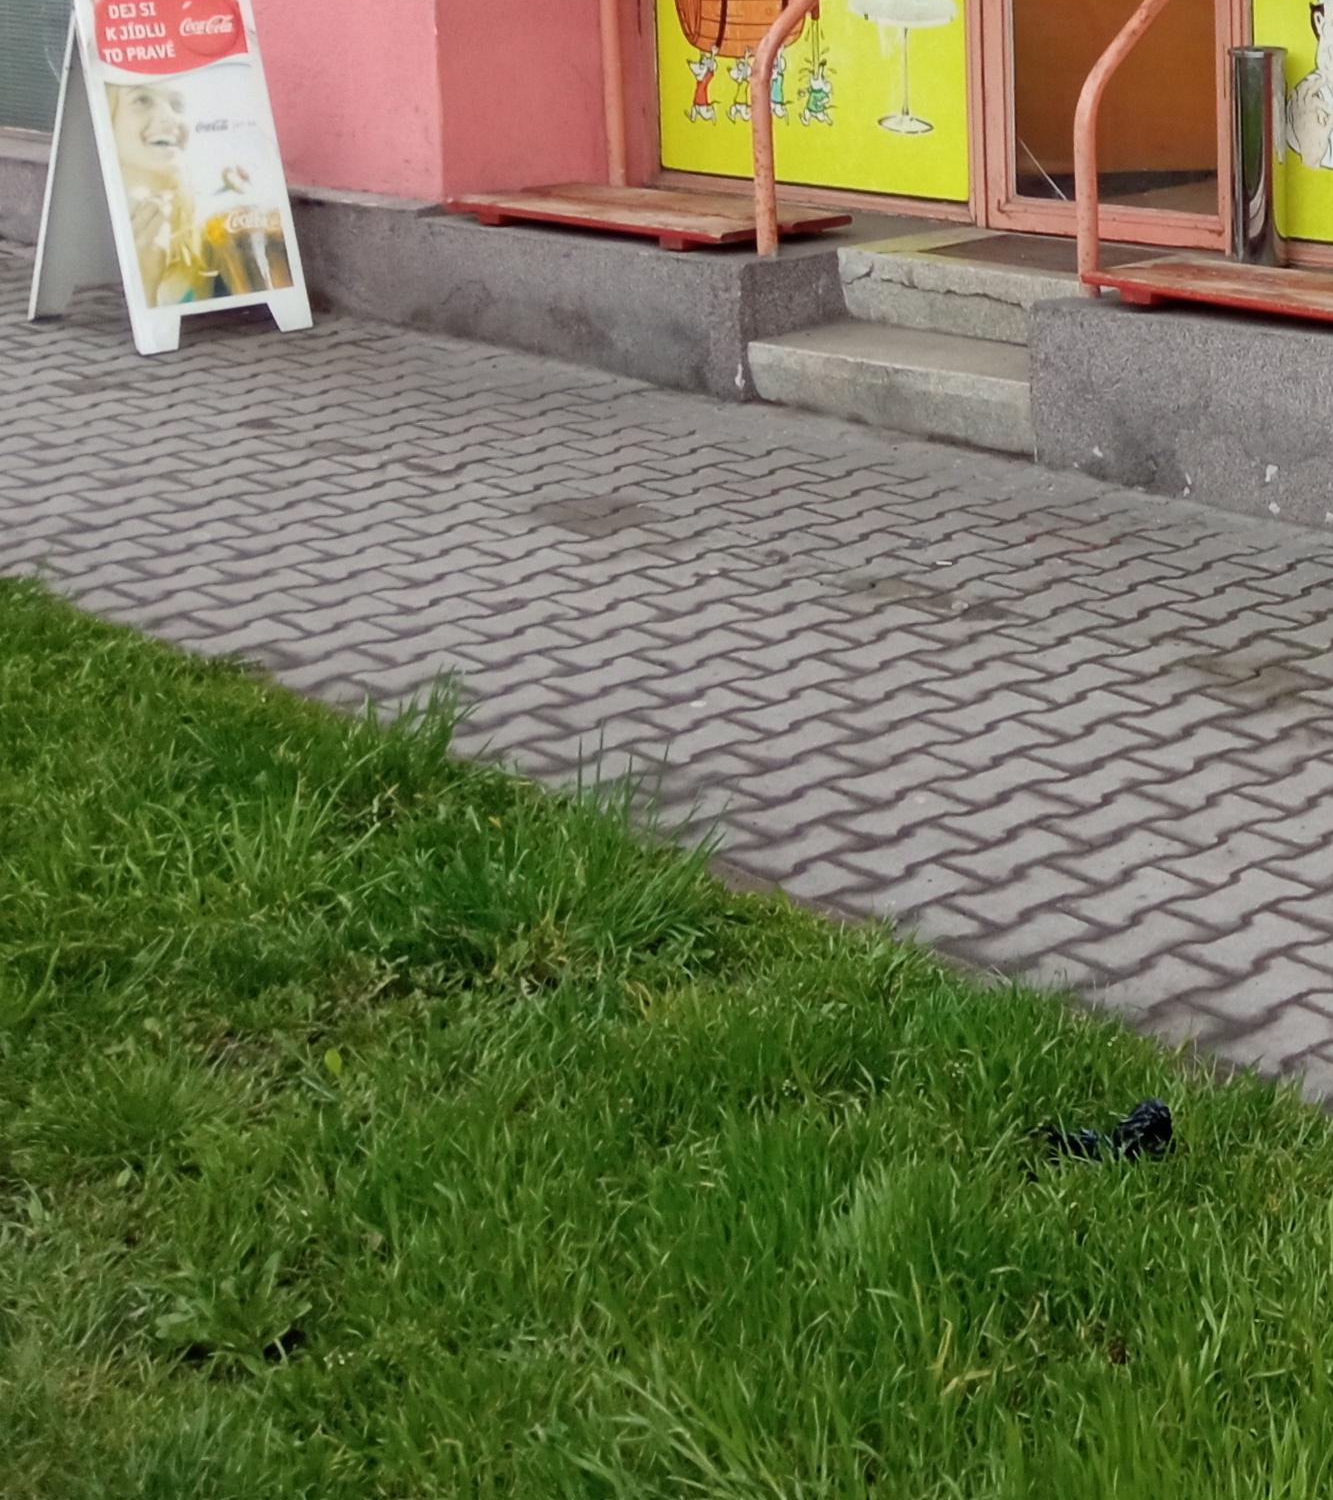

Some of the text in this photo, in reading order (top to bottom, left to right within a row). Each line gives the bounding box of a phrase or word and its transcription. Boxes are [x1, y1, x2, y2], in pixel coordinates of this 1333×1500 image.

[108, 2, 156, 19] DEJ SI
[105, 22, 166, 42] K JÍDLU
[103, 40, 175, 63] TO PRAVÉ
